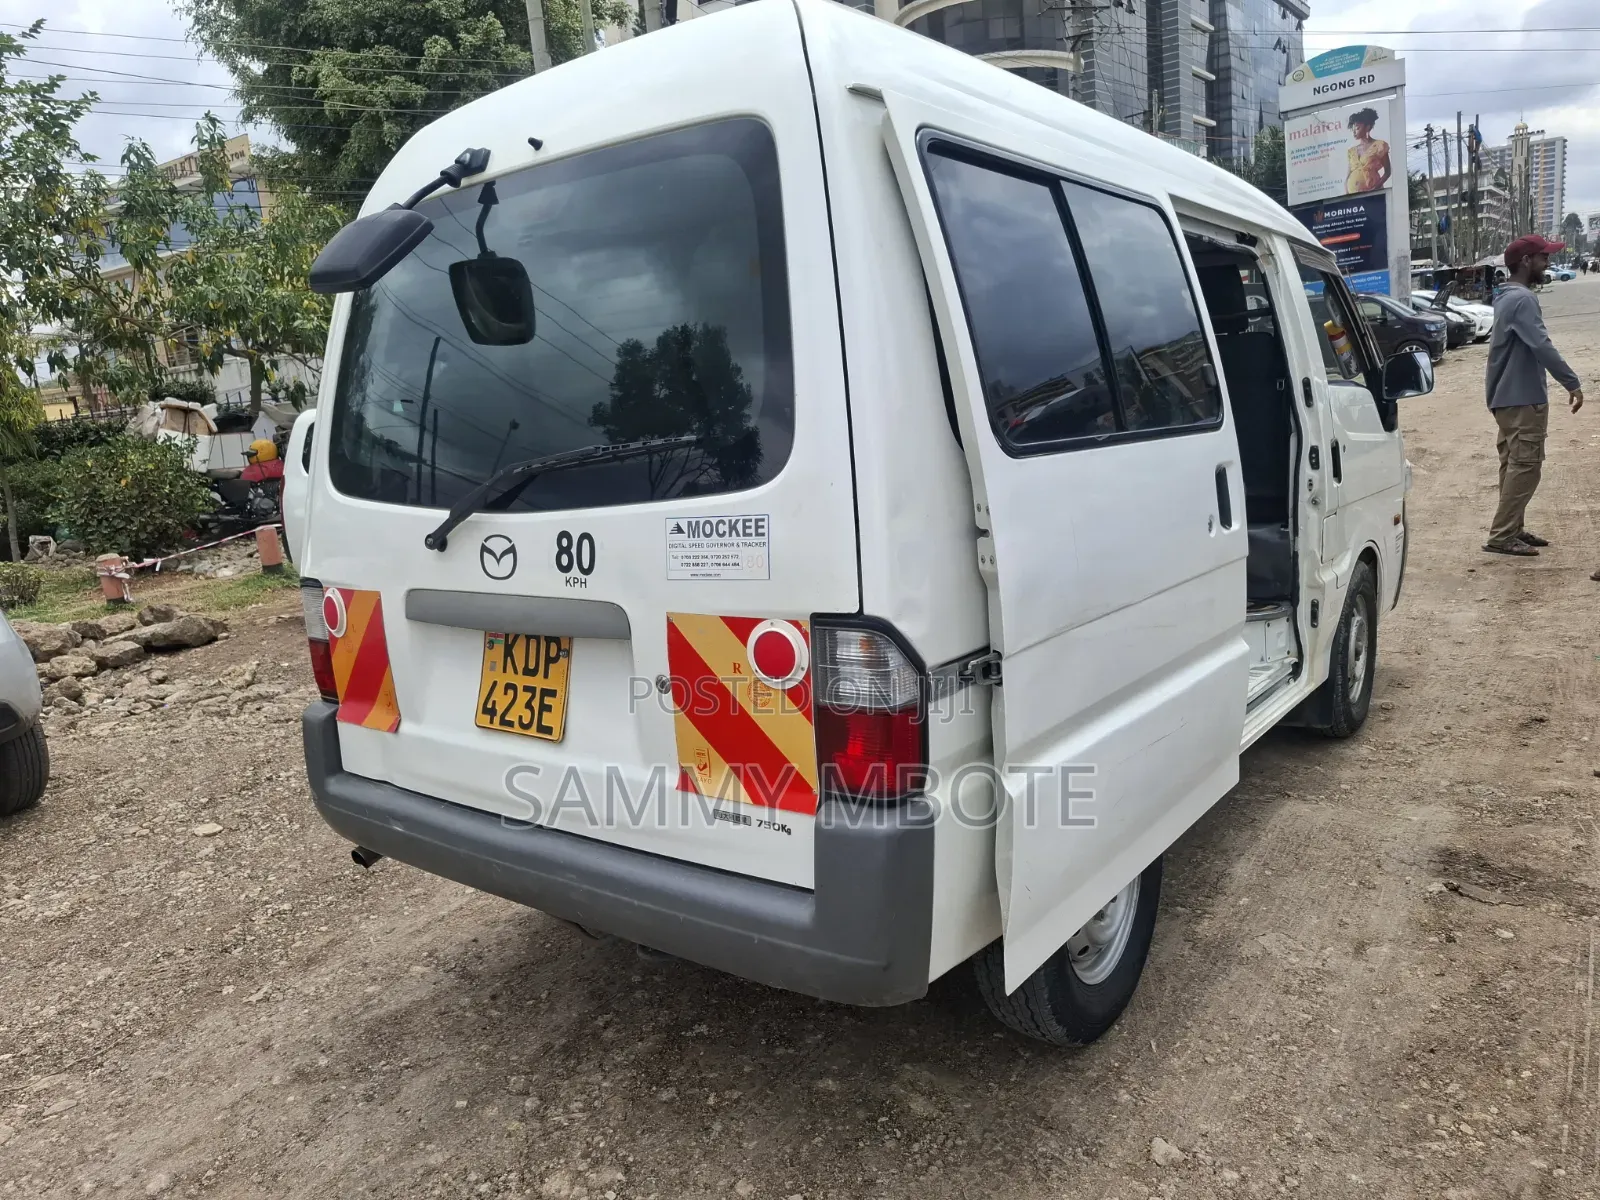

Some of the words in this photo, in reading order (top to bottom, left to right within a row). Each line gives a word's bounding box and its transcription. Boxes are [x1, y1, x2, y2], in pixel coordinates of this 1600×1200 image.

[1313, 79, 1355, 96] NGONG
[1359, 74, 1375, 86] RD
[1289, 121, 1342, 141] malaica
[1317, 138, 1348, 149] pregnancy
[1324, 205, 1365, 218] MORINGA
[687, 518, 766, 539] MOCKEE
[555, 530, 596, 576] 80
[565, 577, 588, 588] KPH
[502, 632, 562, 680] KDP
[732, 662, 742, 674] R
[481, 680, 558, 736] 423E
[756, 818, 792, 836] 750Kg
